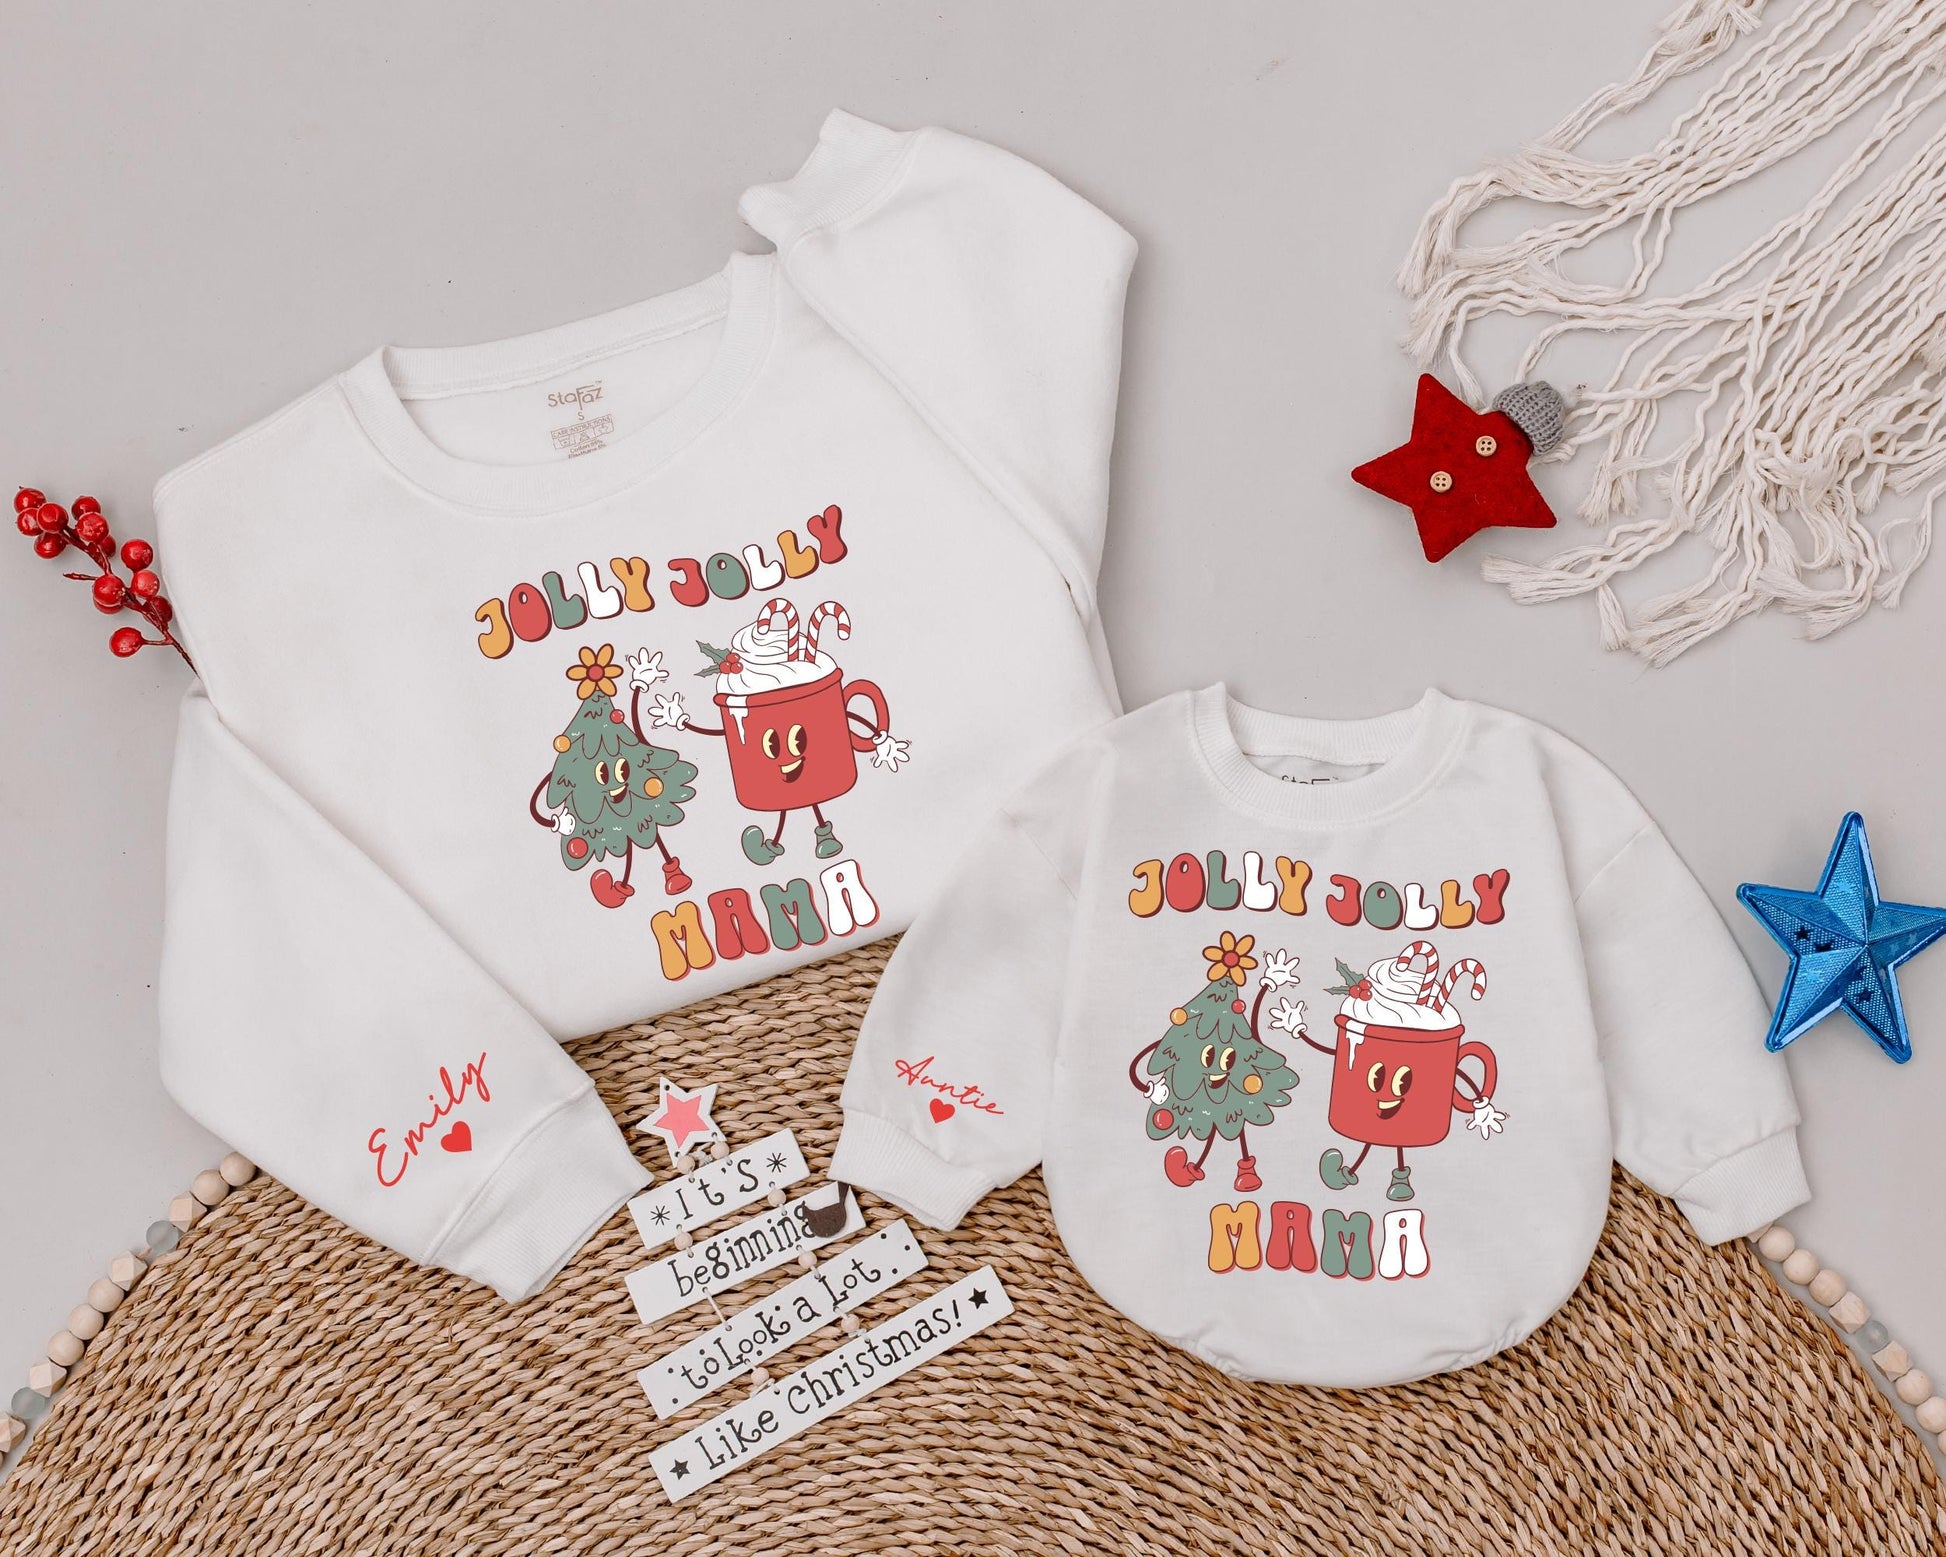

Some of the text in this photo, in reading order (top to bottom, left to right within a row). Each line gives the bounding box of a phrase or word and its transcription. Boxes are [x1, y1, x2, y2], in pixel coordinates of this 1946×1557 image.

[577, 411, 585, 421] S
[474, 504, 849, 660] JOLLY JOLLY
[650, 859, 881, 982] MAMA
[1128, 850, 1511, 931] JOLLY JOLLY
[368, 1052, 491, 1187] Emily
[894, 1056, 1004, 1114] Auntie
[1207, 1200, 1431, 1282] MAMA
[791, 1296, 822, 1323] a
[818, 1256, 883, 1307] Lot
[694, 1410, 780, 1472] Like
